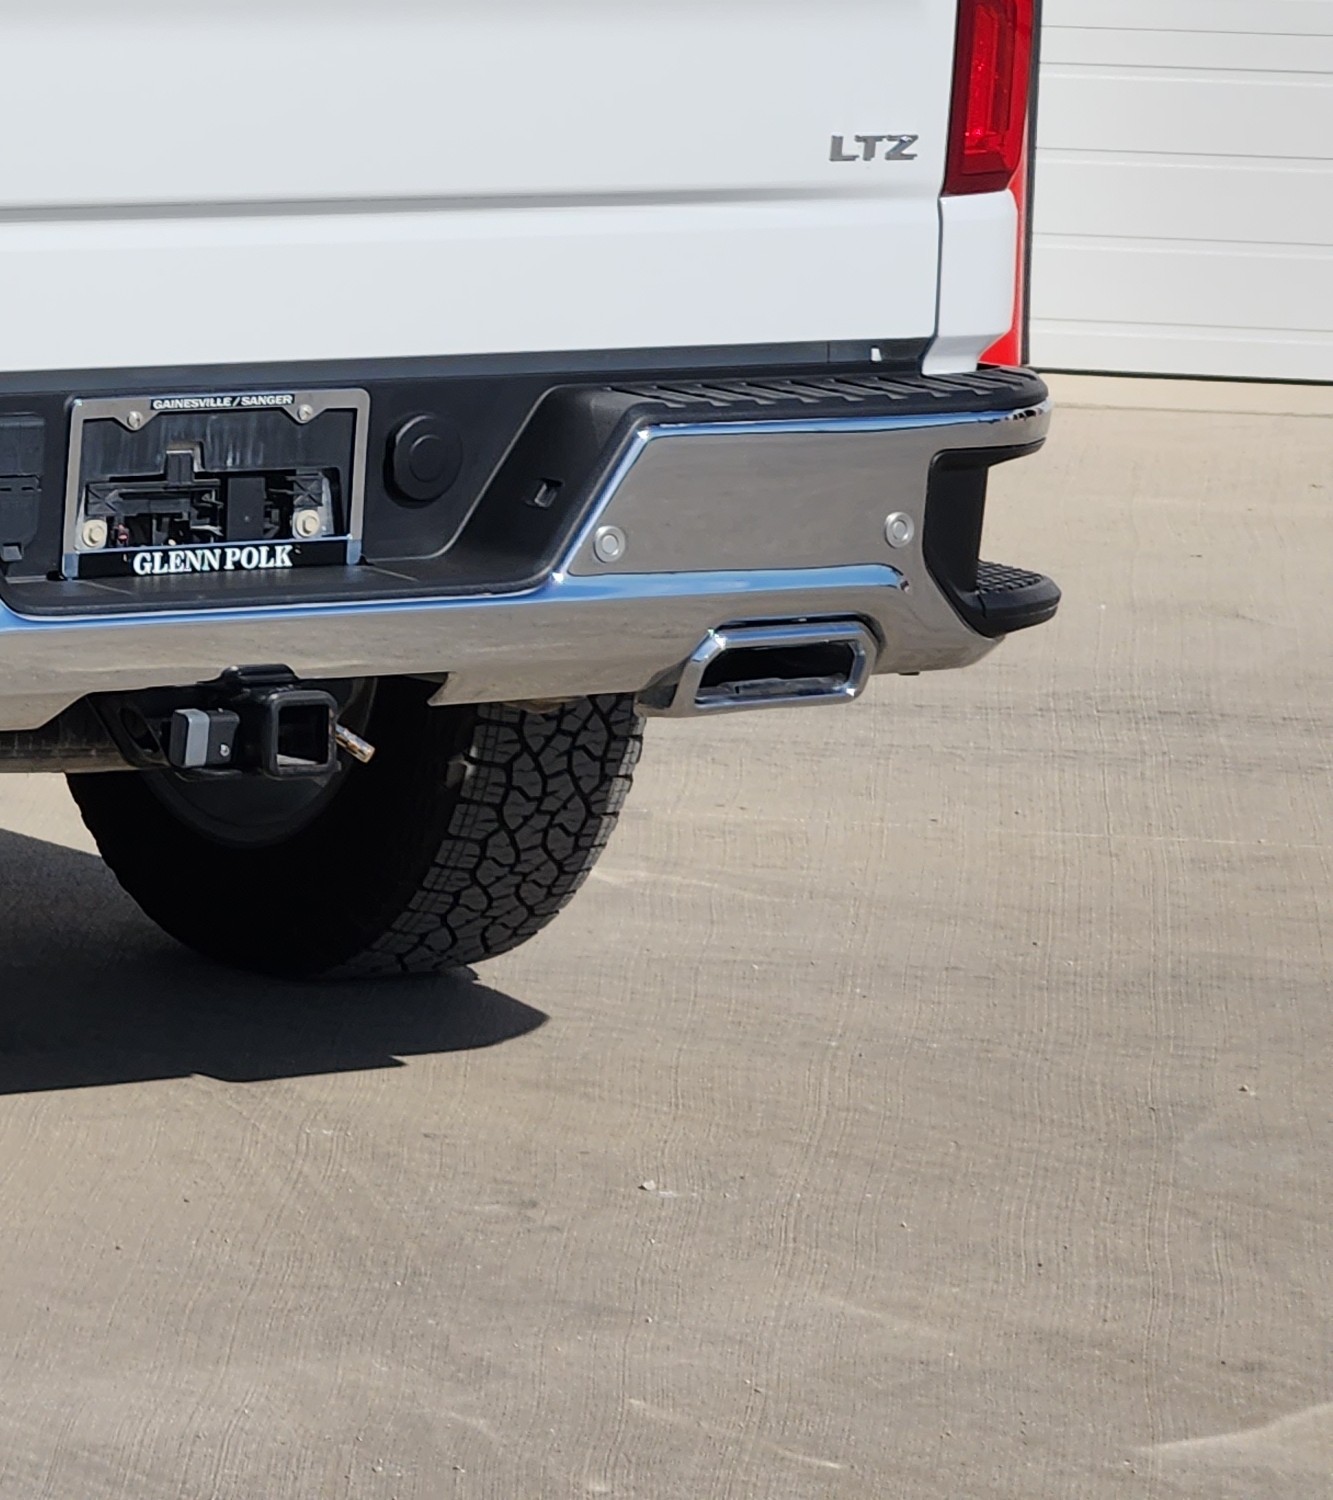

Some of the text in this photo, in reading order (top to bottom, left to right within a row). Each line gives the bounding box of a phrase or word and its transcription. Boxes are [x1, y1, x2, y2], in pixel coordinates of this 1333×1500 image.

[829, 134, 919, 161] LTZ
[133, 545, 293, 575] GLENN POLK
